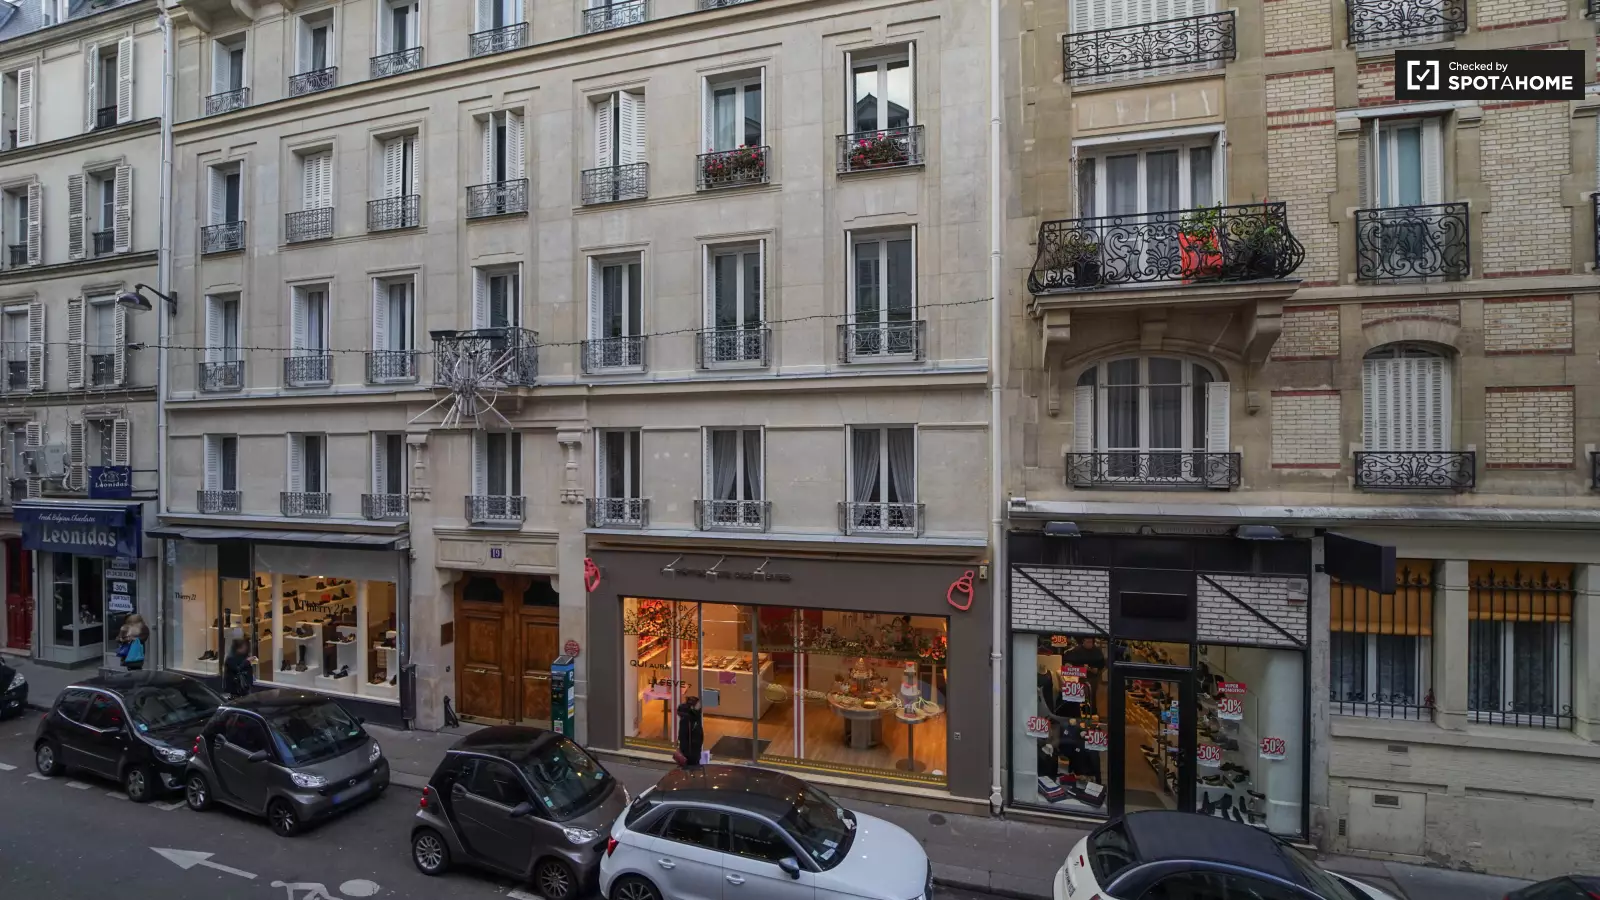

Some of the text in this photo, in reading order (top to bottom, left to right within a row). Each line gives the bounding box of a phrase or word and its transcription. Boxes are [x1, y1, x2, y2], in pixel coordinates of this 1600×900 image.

[42, 523, 117, 547] Leonidas
[492, 549, 500, 558] 19
[629, 660, 648, 668] QUI
[1062, 682, 1085, 696] -50%
[1218, 699, 1242, 713] -50%
[1028, 717, 1049, 732] -50%
[1085, 731, 1107, 745] -50%
[1197, 746, 1220, 760] -50%
[1260, 739, 1285, 753] -50%
